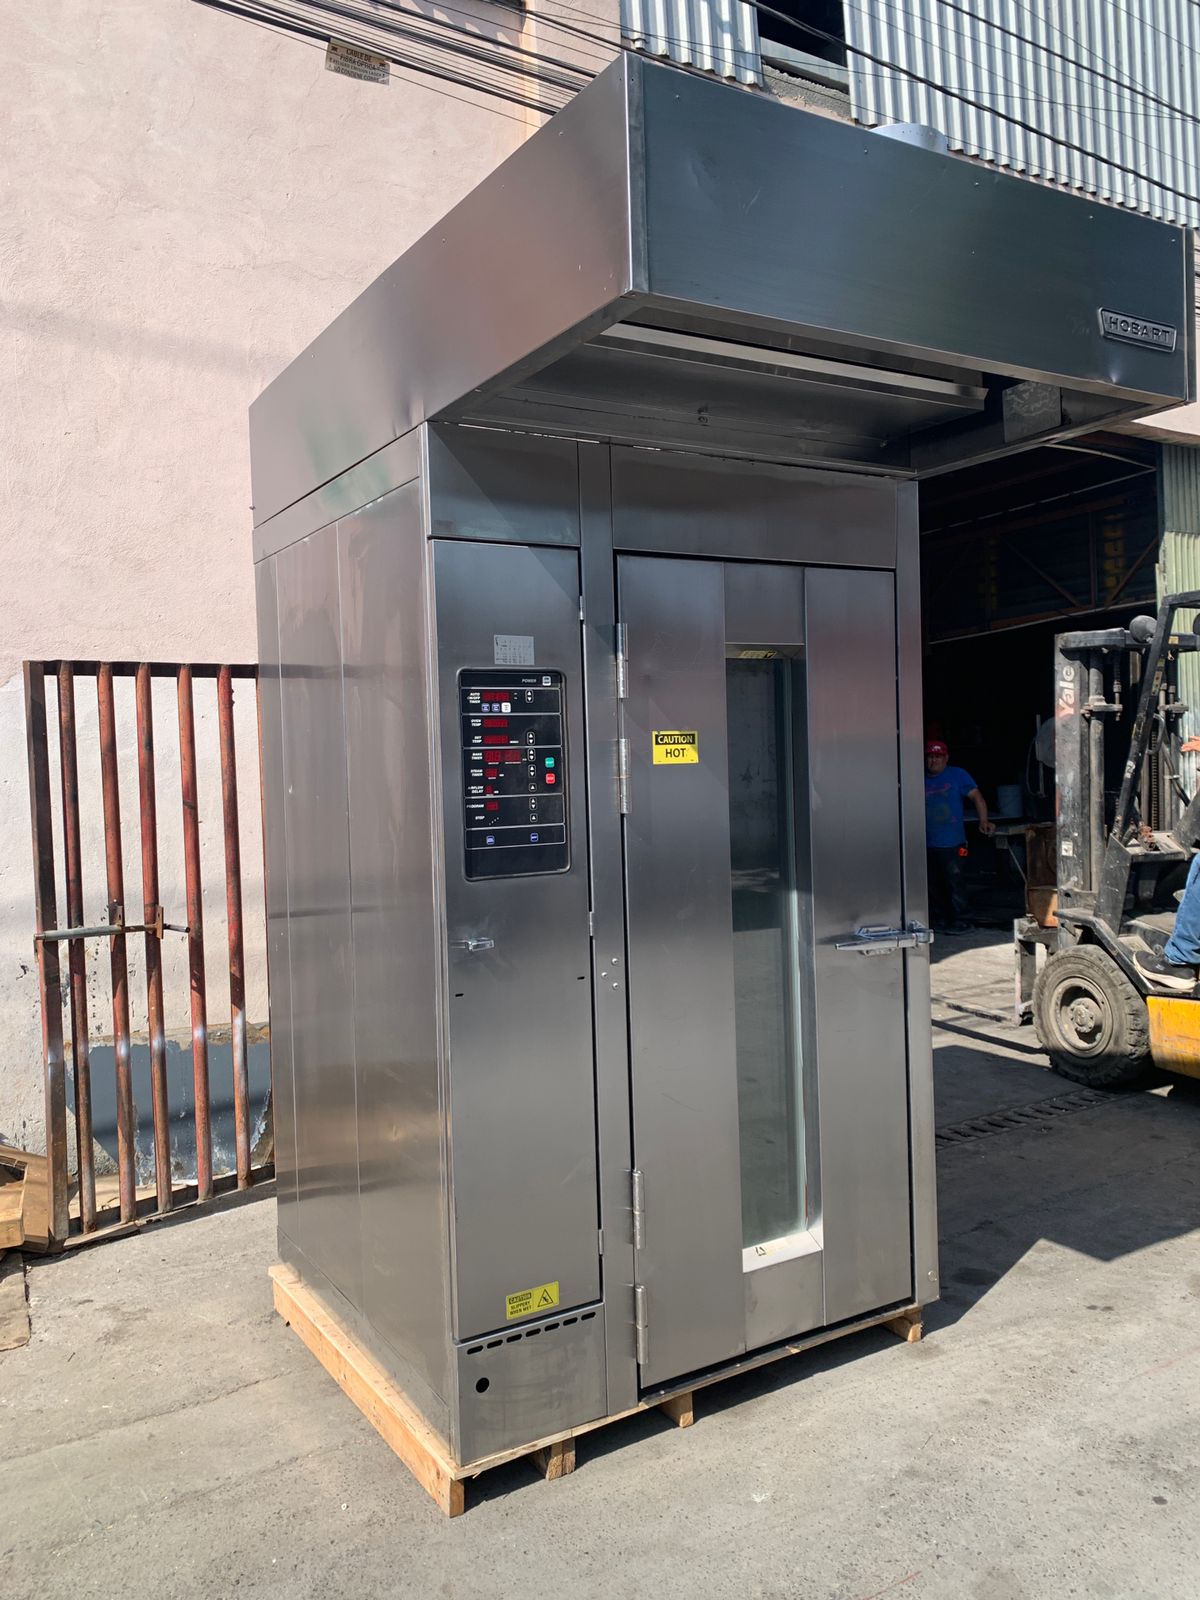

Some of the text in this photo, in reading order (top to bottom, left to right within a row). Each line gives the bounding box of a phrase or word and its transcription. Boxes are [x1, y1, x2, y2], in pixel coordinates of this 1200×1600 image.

[346, 49, 372, 62] CABLE DE
[1109, 316, 1170, 342] HOBART
[1059, 665, 1075, 717] Yale
[657, 736, 692, 744] CAUTION
[665, 748, 686, 758] HOT
[510, 1301, 530, 1310] SLIPPERY
